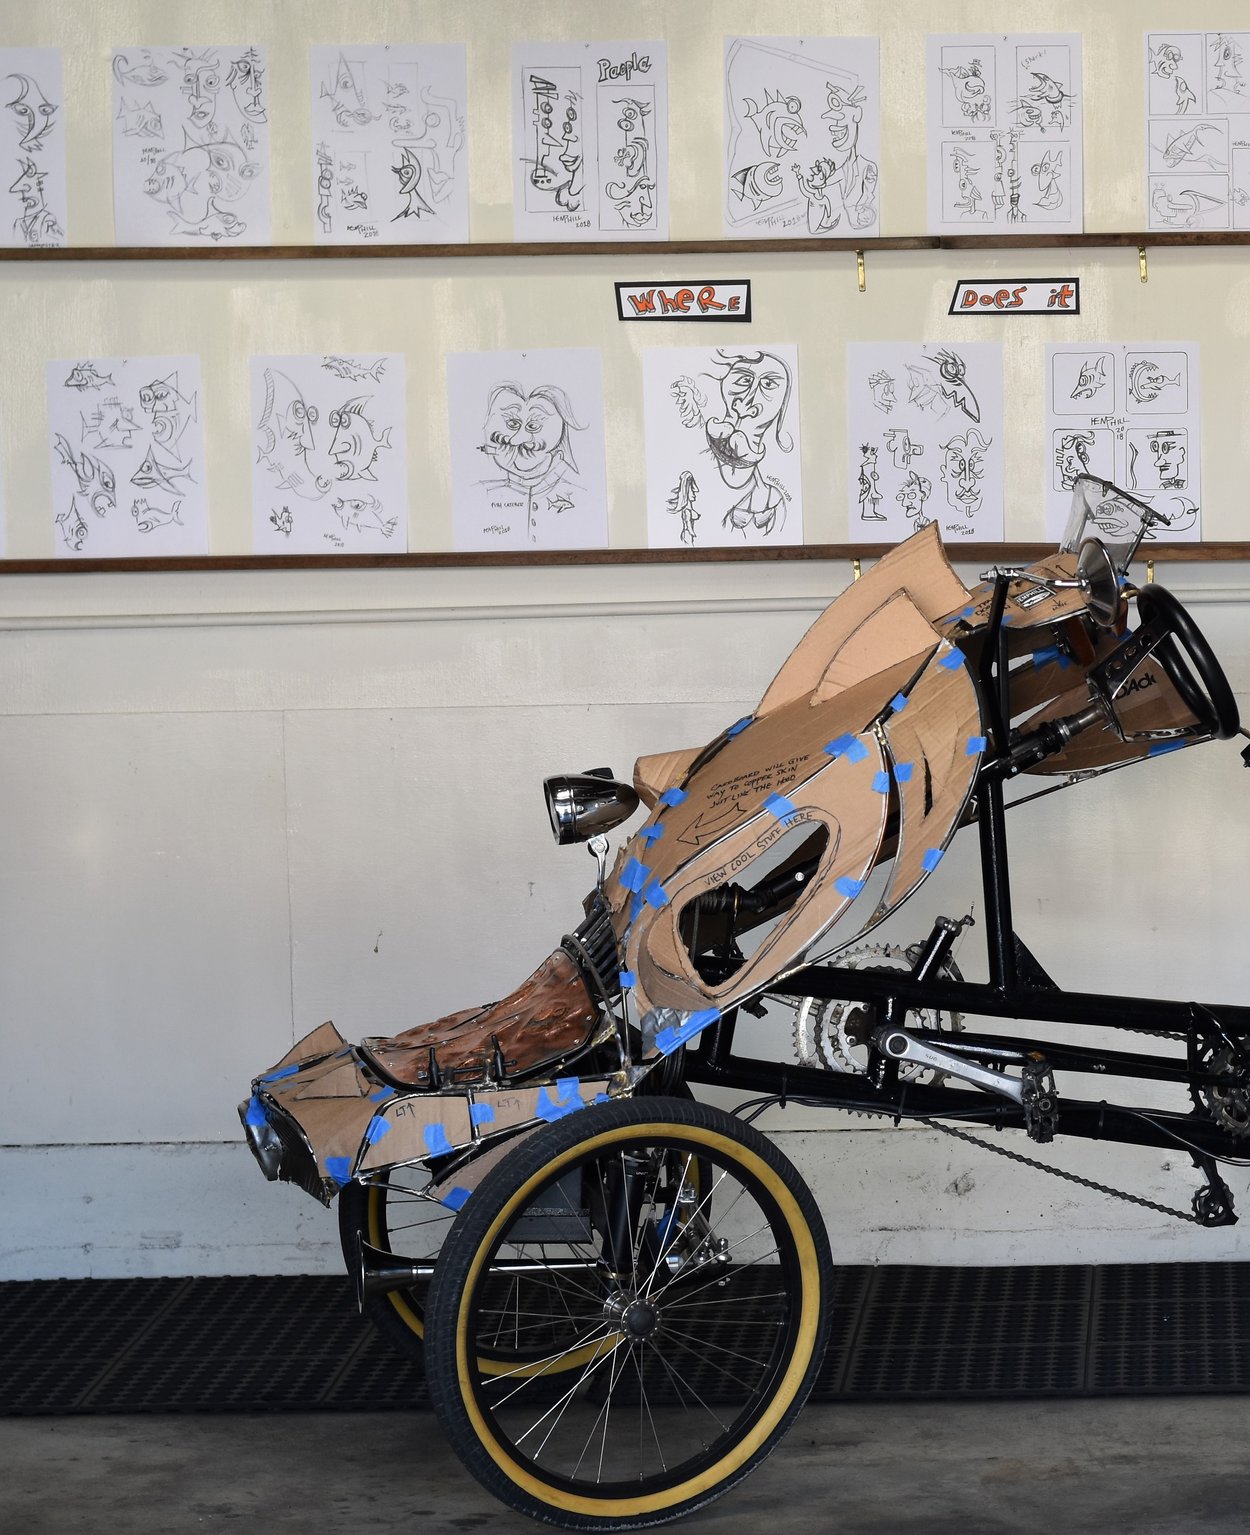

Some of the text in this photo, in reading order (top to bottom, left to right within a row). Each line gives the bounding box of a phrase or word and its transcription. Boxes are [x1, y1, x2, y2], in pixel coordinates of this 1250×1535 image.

[960, 284, 1074, 310] Does it
[764, 761, 785, 773] WILL
[787, 753, 811, 766] GIVE
[775, 764, 799, 776] SKIN
[753, 781, 773, 794] THE
[703, 811, 815, 886] VIEW COOL STUFF HERE
